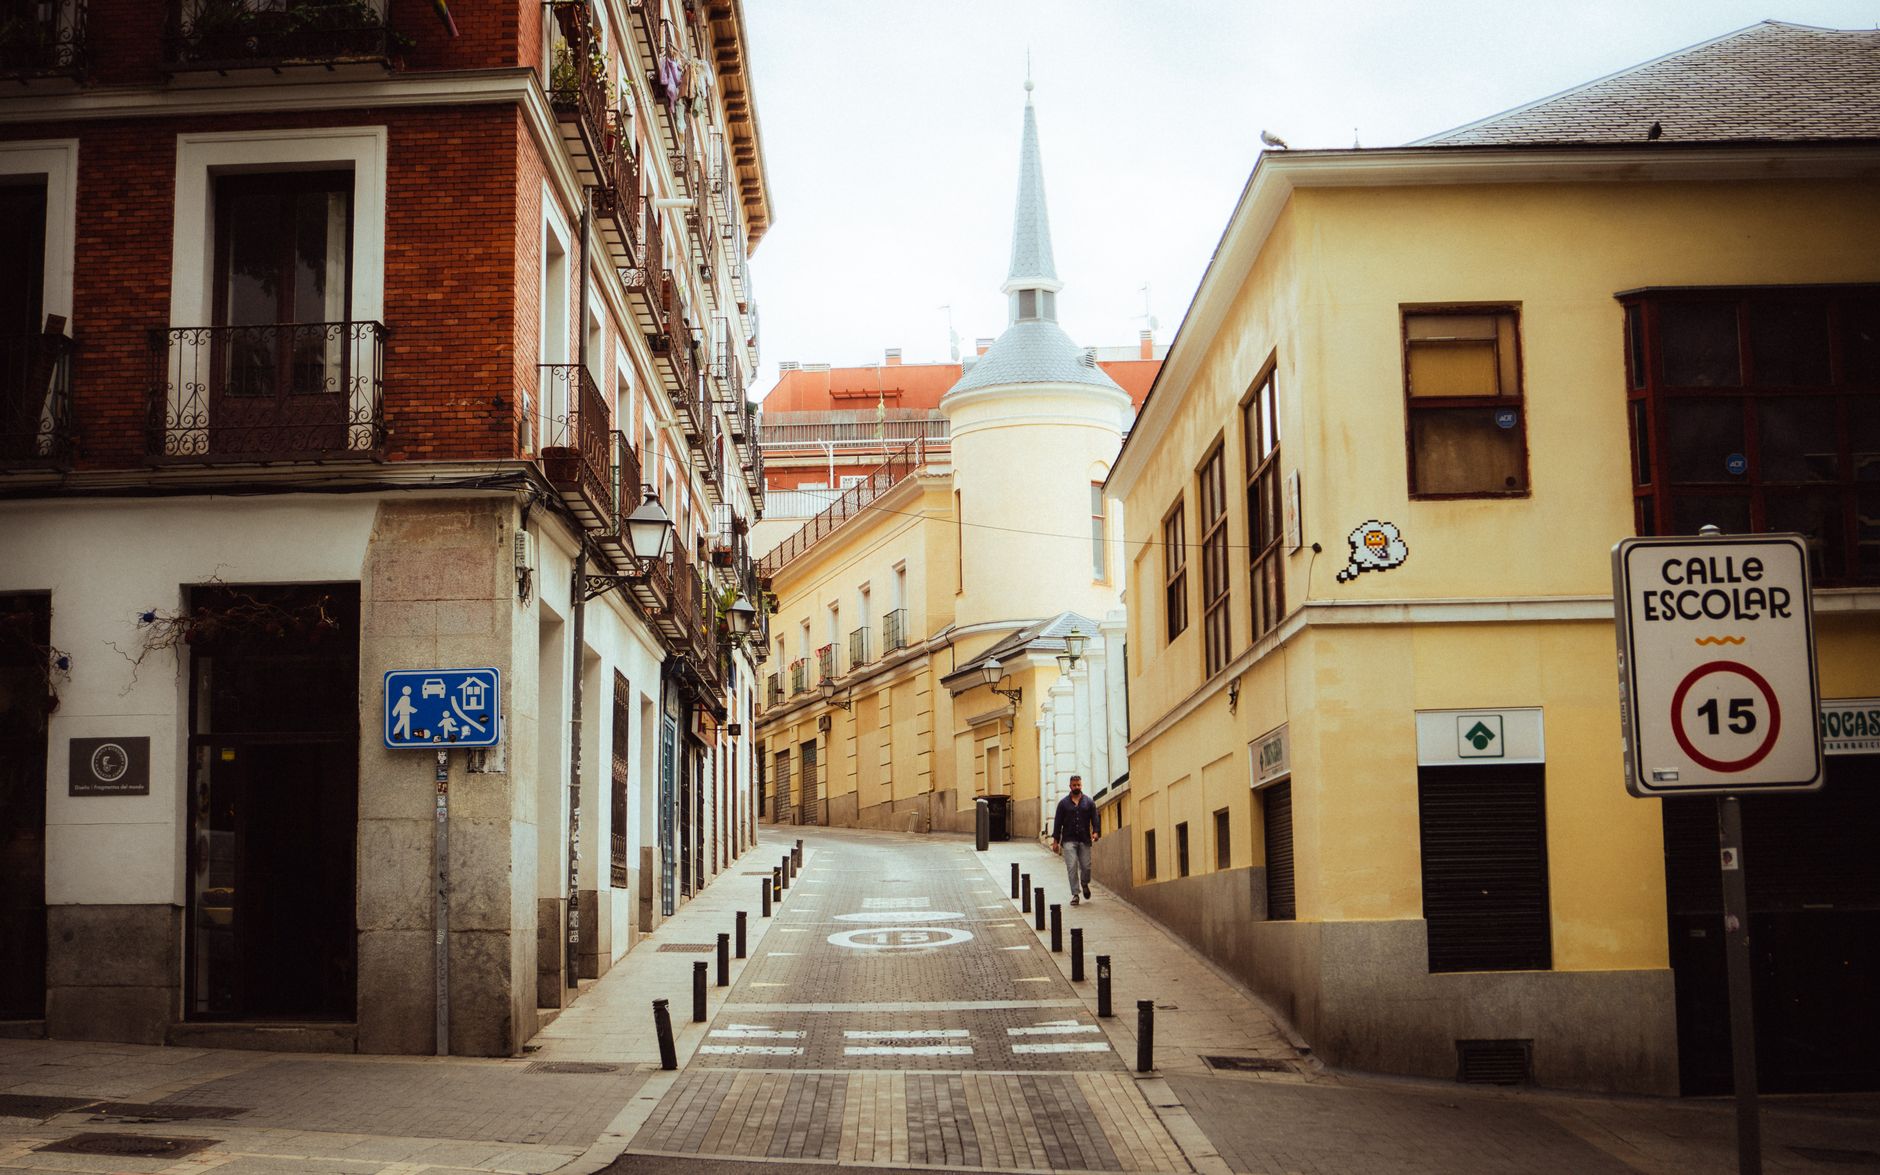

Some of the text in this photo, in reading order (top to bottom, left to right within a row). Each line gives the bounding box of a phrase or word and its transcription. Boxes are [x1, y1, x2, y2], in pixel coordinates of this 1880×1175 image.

[1643, 587, 1792, 621] ESCOLAR
[1697, 698, 1757, 735] 15
[871, 932, 929, 944] 15
